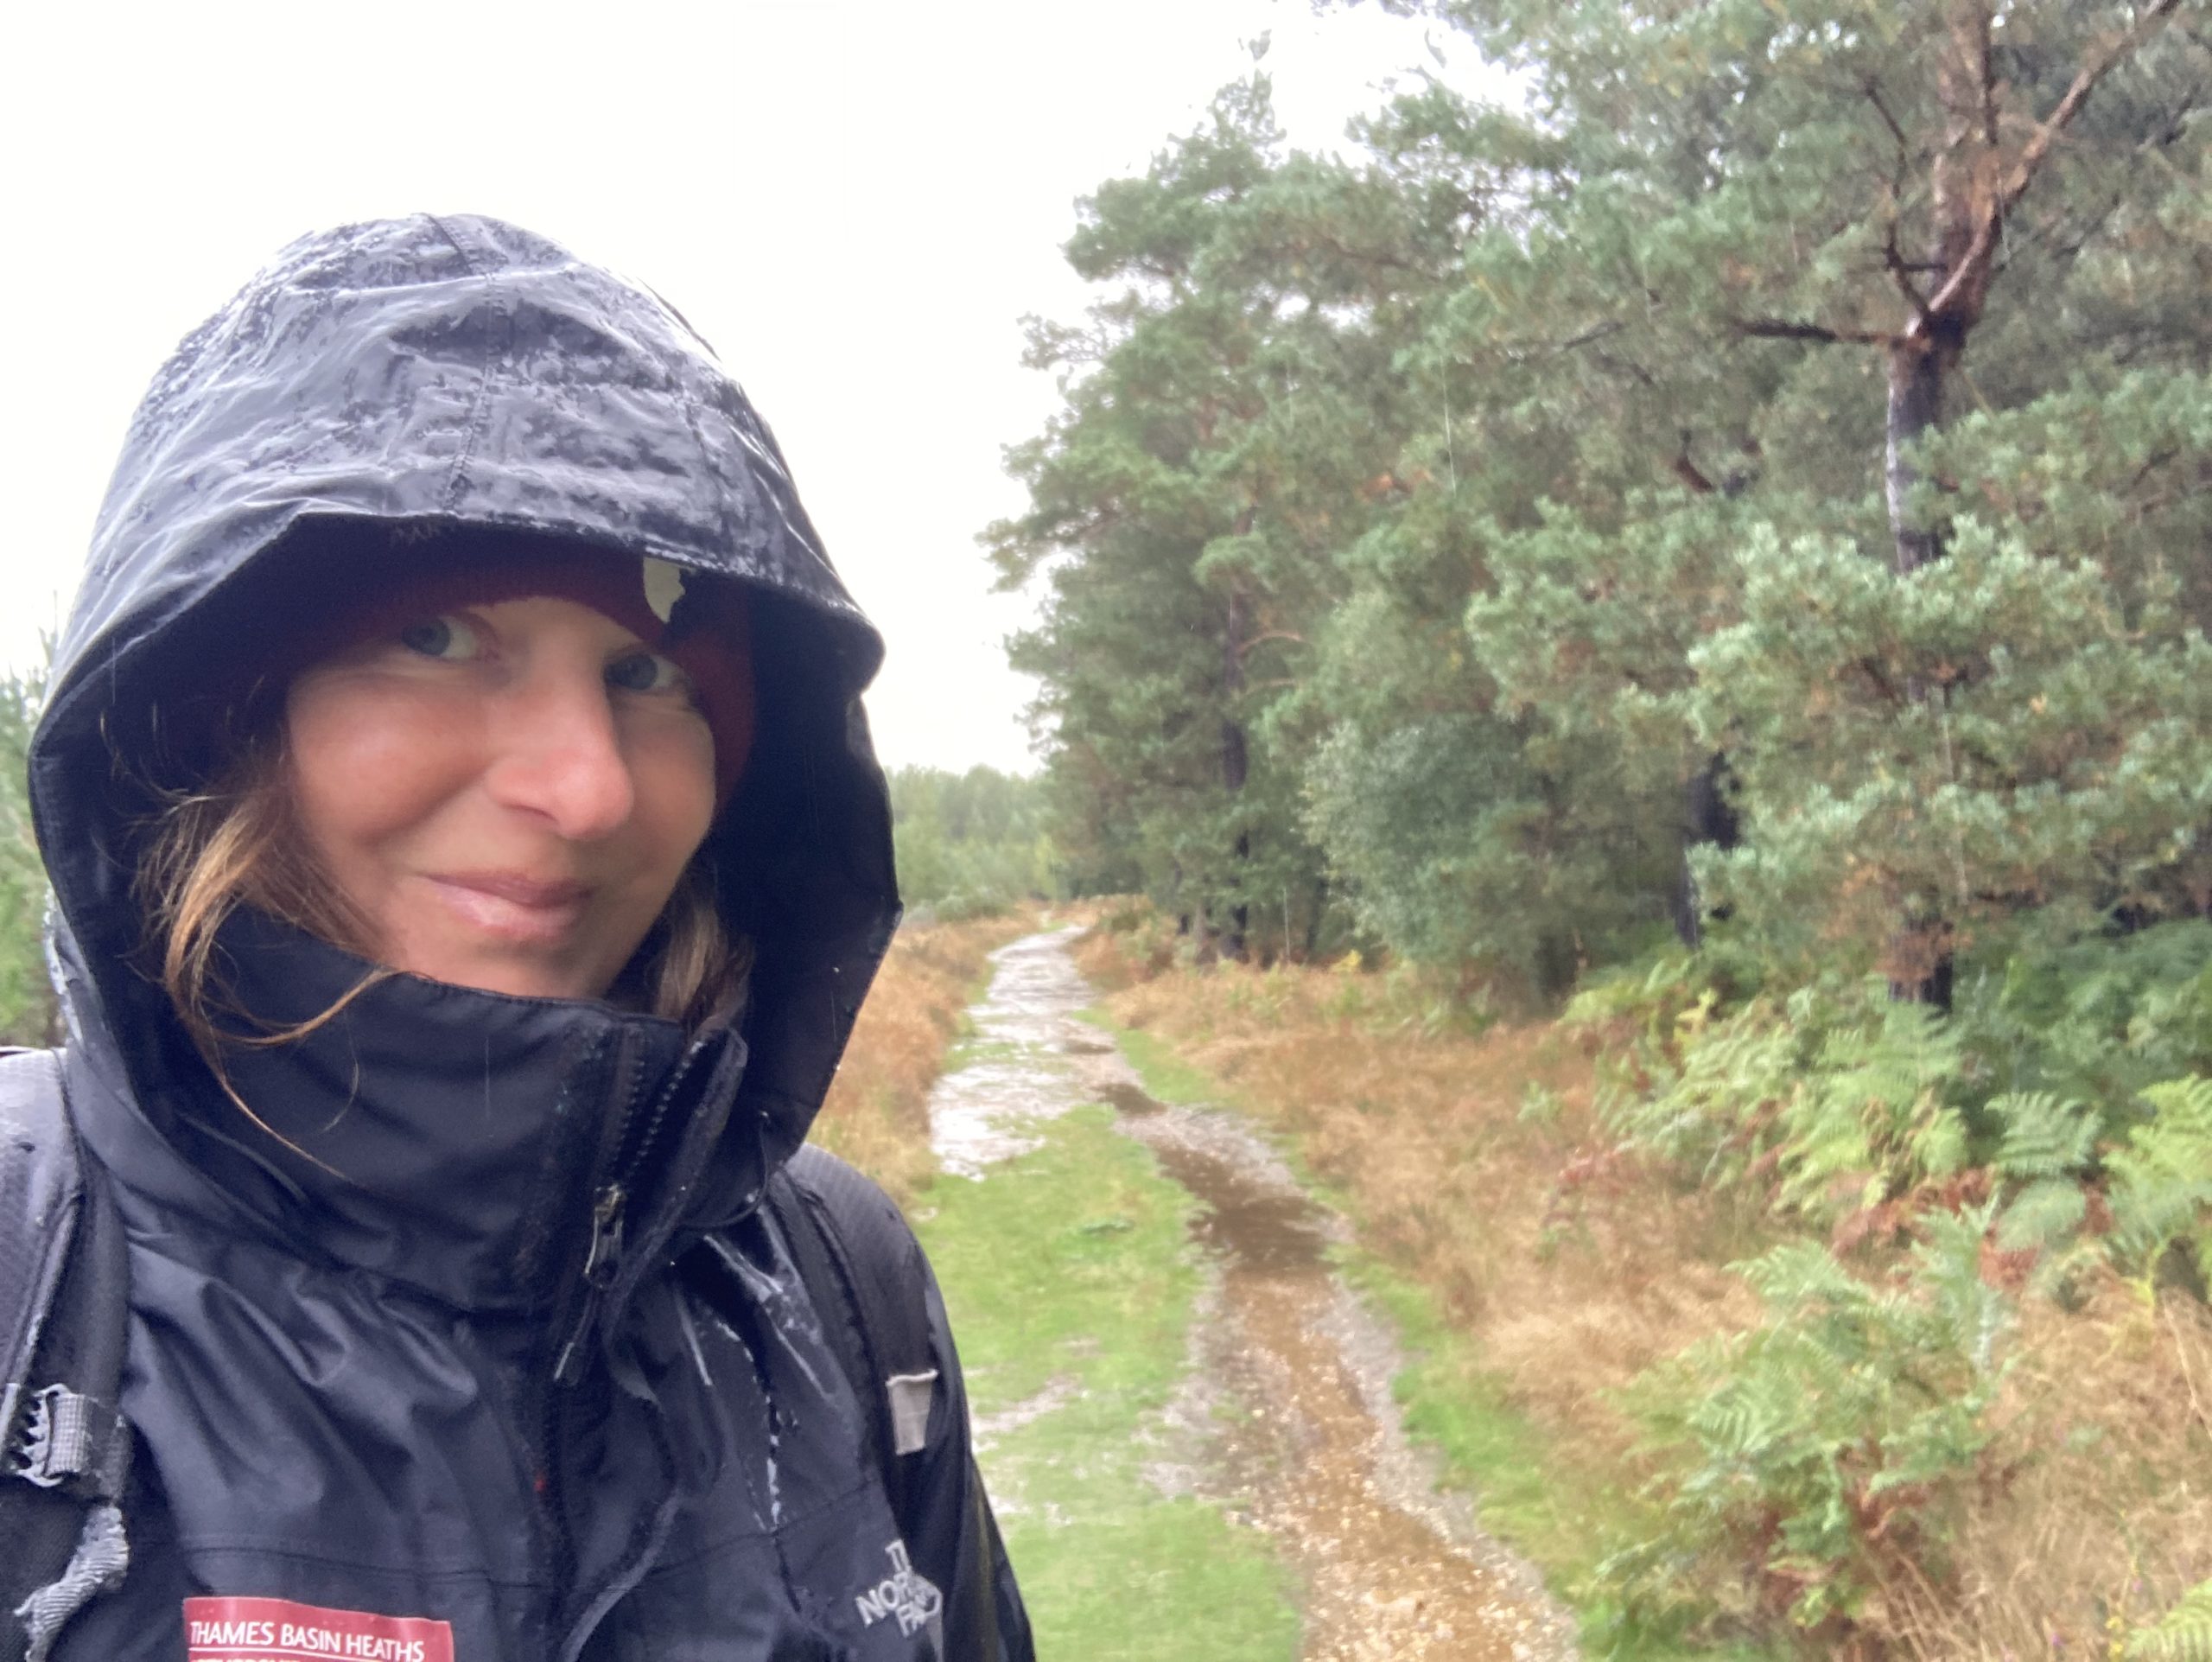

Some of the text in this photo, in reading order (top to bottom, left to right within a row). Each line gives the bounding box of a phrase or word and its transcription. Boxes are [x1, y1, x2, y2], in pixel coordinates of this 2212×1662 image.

[189, 1621, 425, 1662] THAMES BASIN HEATHS
